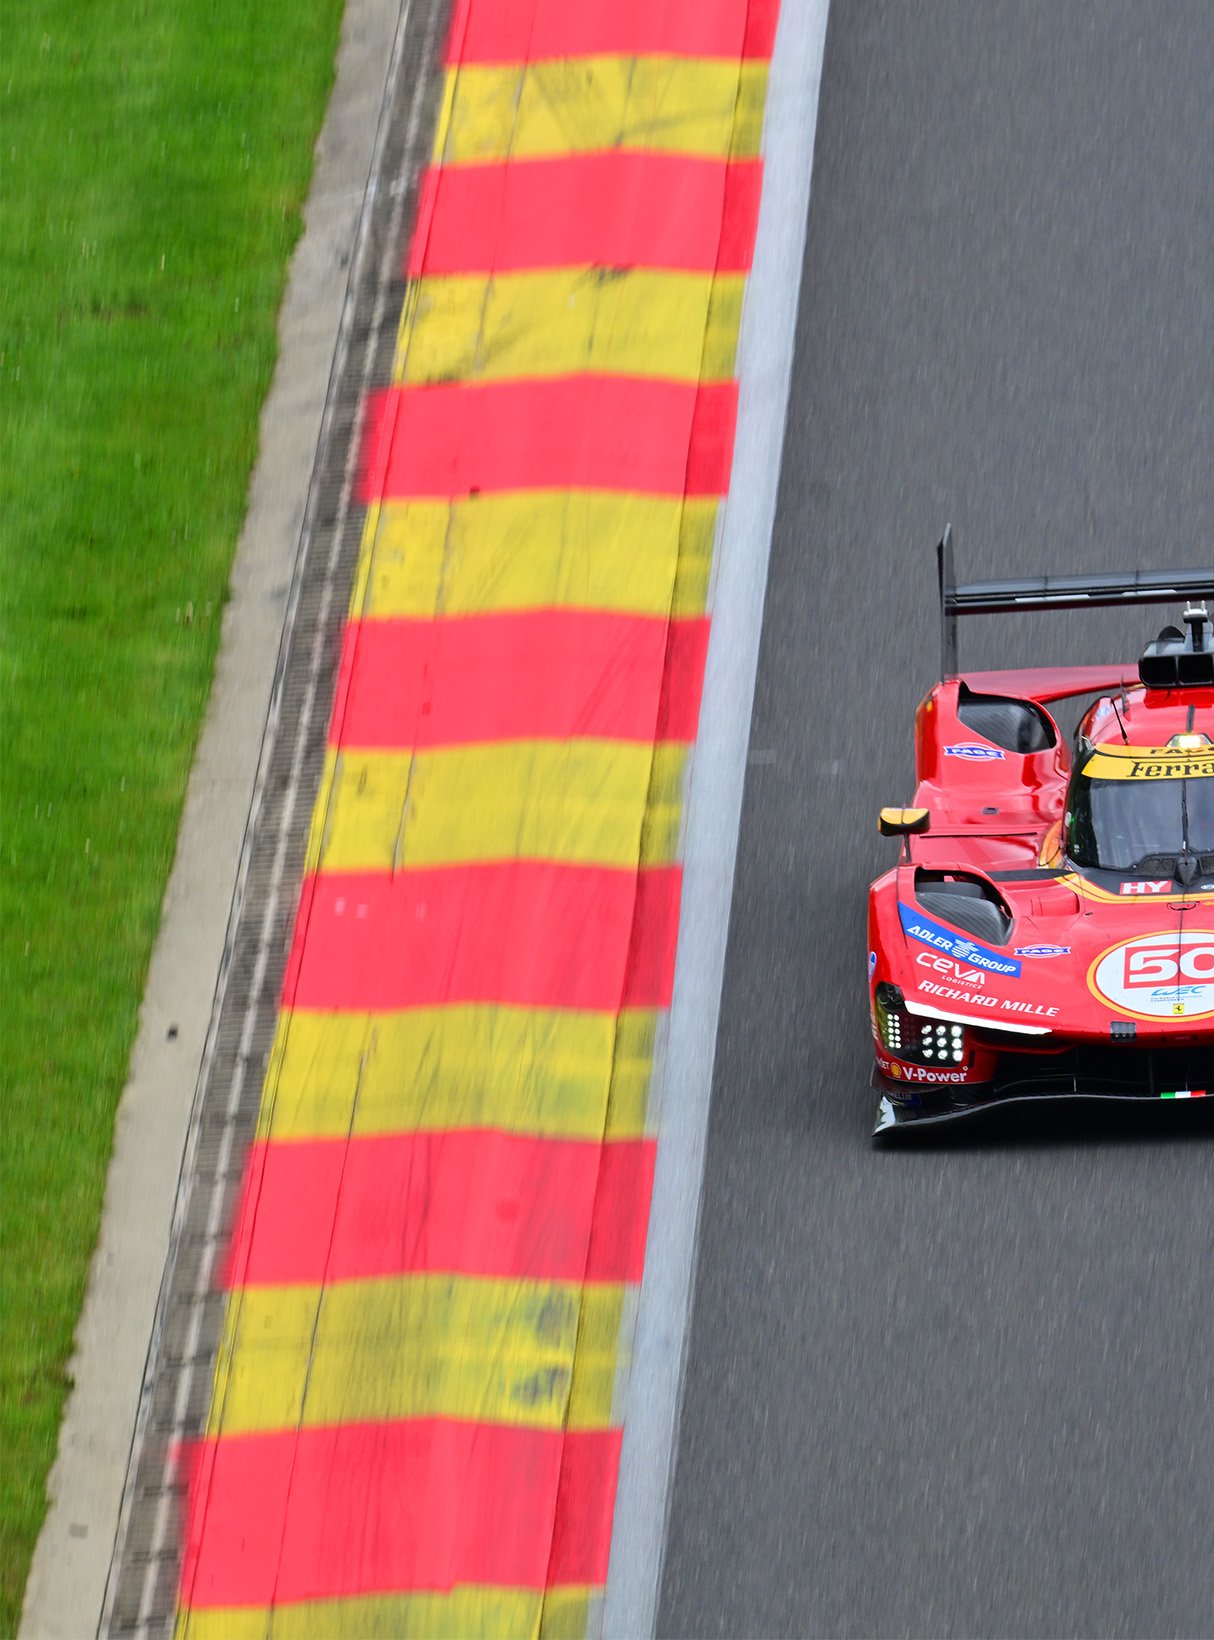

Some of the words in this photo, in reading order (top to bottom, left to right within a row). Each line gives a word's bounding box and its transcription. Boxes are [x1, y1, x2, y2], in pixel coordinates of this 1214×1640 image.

[1122, 880, 1168, 894] HY
[906, 925, 953, 951] ADLER
[968, 954, 1017, 973] GROUP
[941, 974, 983, 990] LOGISTICS
[918, 979, 998, 1007] RICHARD
[1000, 1000, 1060, 1017] MILLE
[1151, 985, 1206, 996] WEC
[902, 1066, 967, 1082] V-Power
